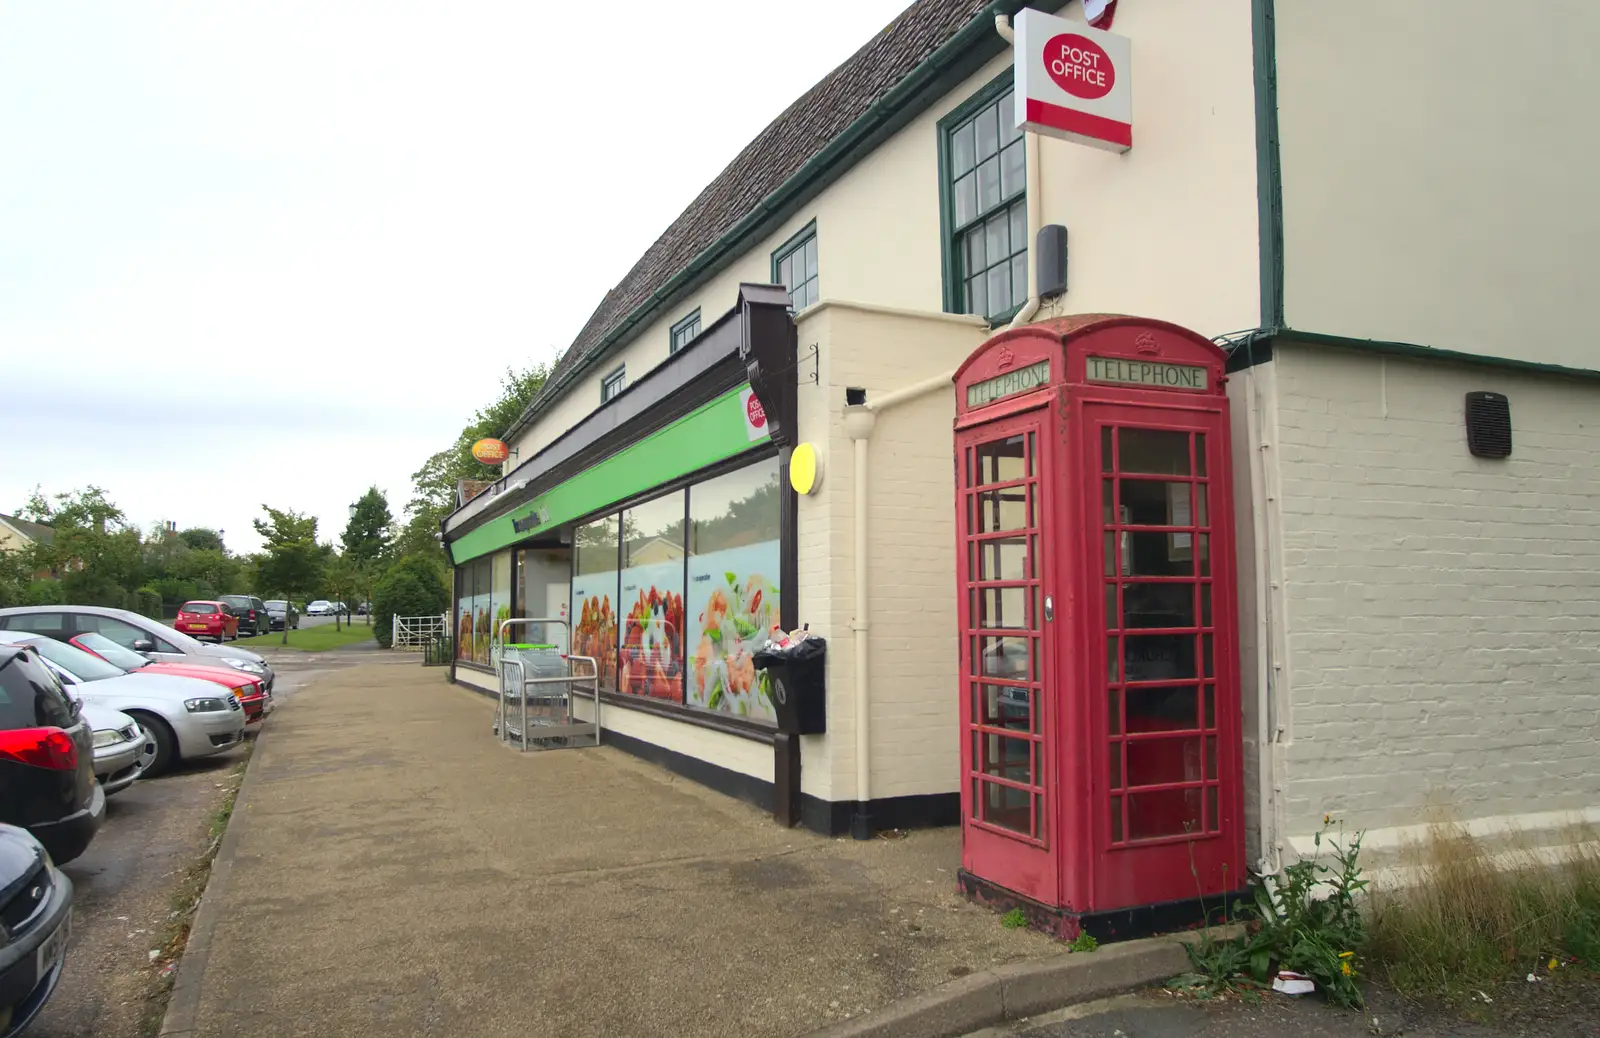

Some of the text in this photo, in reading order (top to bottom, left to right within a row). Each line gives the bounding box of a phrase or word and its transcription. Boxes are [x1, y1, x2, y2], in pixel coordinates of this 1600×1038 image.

[1061, 44, 1100, 68] POST
[1051, 59, 1106, 87] OFFICE
[972, 361, 1049, 403] TELEPHONE
[1090, 358, 1202, 388] TELEPHONE
[476, 450, 504, 458] OFFICE
[479, 442, 502, 451] POST
